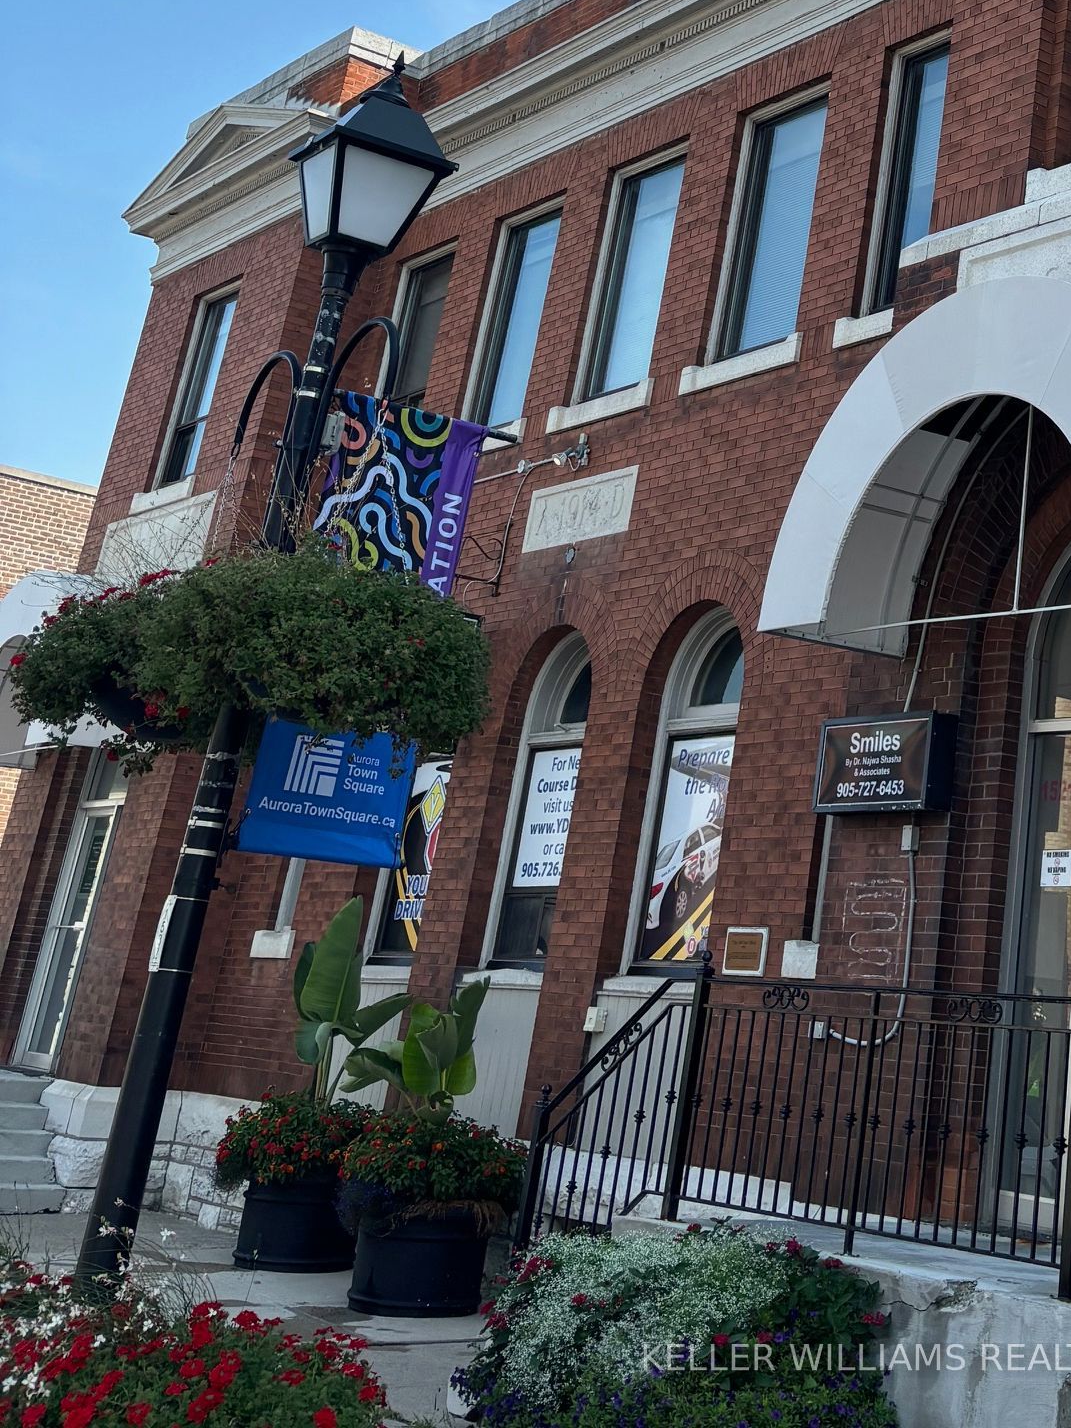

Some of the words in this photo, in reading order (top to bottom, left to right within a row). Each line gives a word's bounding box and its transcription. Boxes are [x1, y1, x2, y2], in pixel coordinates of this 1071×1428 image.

[427, 492, 463, 597] ATION
[850, 730, 901, 753] Smiles
[349, 753, 380, 767] Aurora
[551, 757, 566, 772] For
[678, 748, 730, 771] Prepare
[845, 758, 853, 767] By
[853, 757, 861, 765] Dr.
[862, 756, 880, 766] Najwa
[880, 755, 902, 764] Shasha
[348, 764, 378, 780] Town
[854, 768, 859, 777] &
[859, 767, 891, 776] Associates
[343, 778, 385, 795] Square
[537, 778, 569, 793] Course
[684, 775, 706, 795] the
[836, 779, 905, 798] 905-727-6453
[258, 796, 396, 828] AuroraTownSquare.ca
[543, 798, 562, 813] visit
[530, 818, 569, 834] www.YD
[543, 844, 553, 855] or
